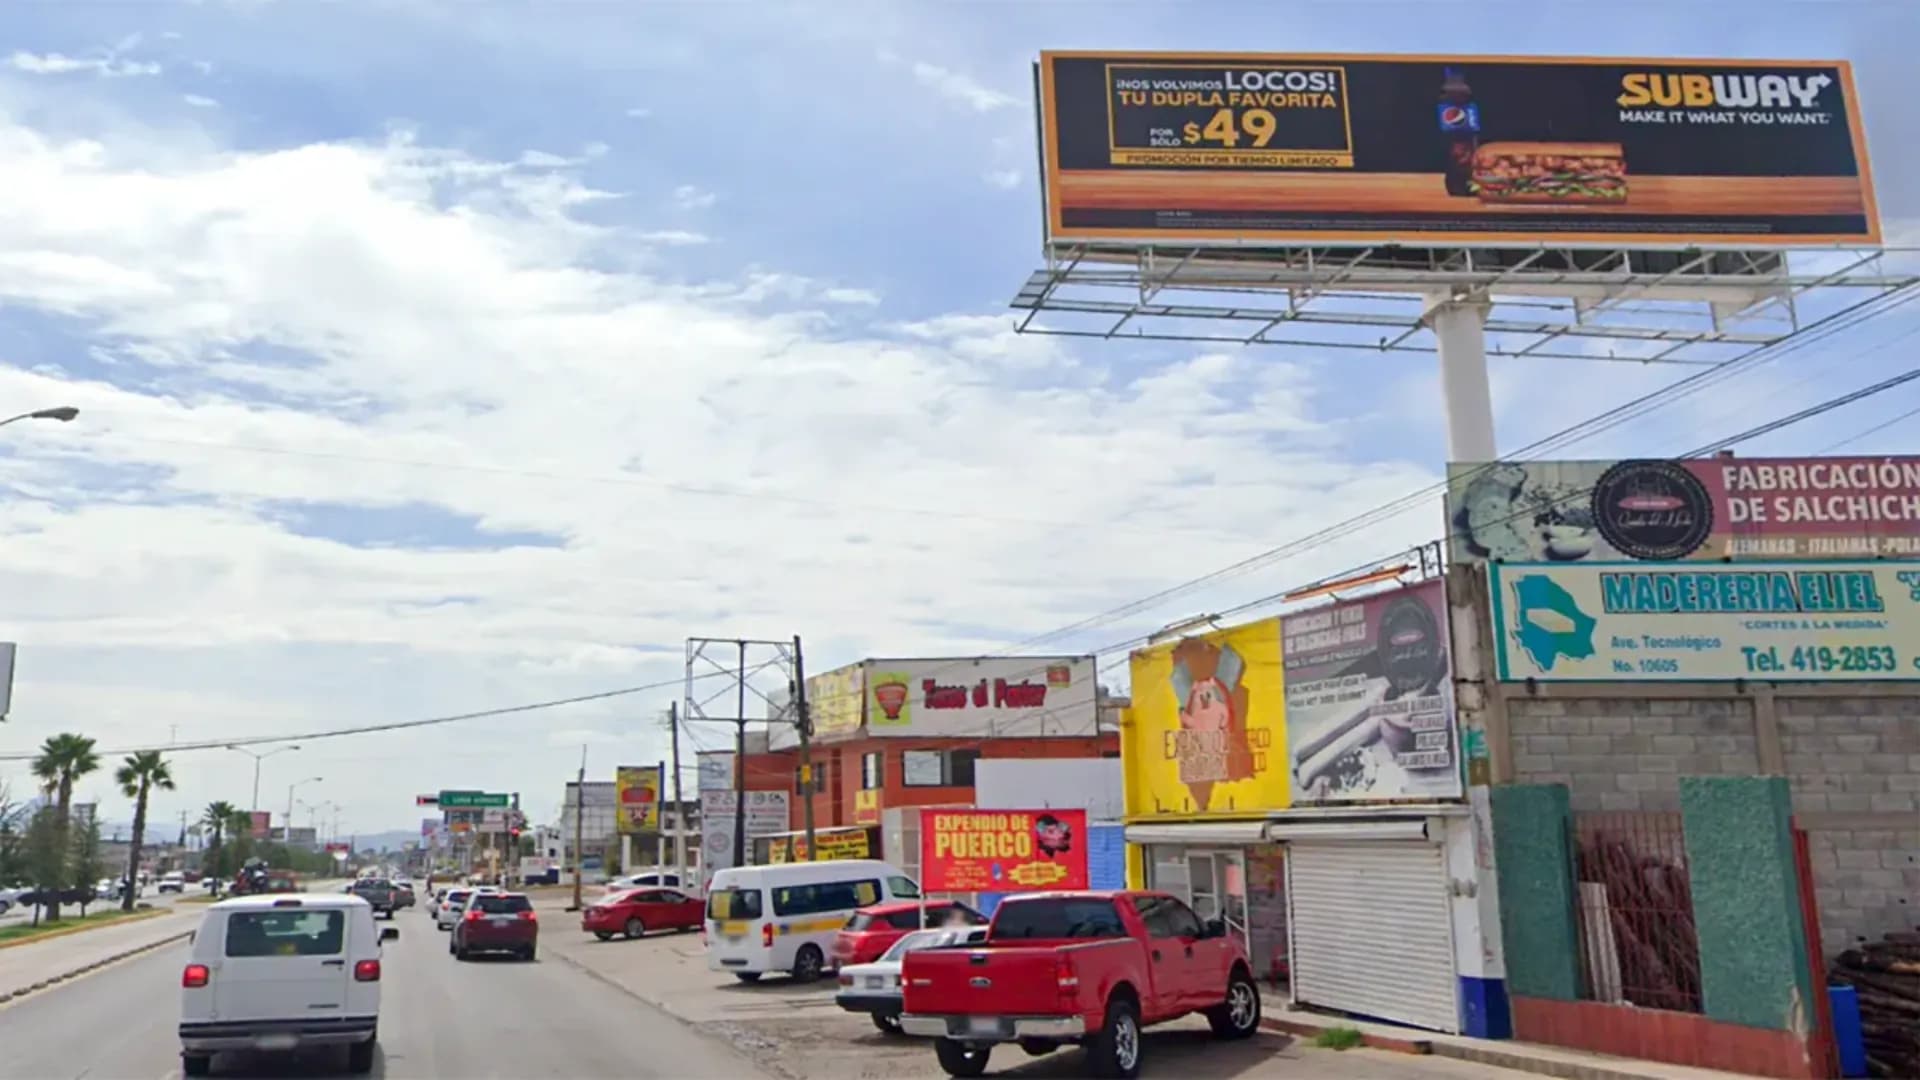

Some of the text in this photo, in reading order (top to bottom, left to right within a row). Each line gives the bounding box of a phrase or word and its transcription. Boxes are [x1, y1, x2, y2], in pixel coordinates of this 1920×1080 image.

[1152, 80, 1223, 91] VOLVIMOS
[1225, 71, 1337, 92] LOCOS!
[1617, 73, 1832, 108] SUBWAY
[1117, 91, 1337, 108] TU DUPLA FAVORITA
[1619, 110, 1666, 123] MAKE
[1669, 110, 1684, 123] IT
[1687, 111, 1735, 123] WHAT
[1739, 112, 1774, 124] YOU
[1150, 128, 1174, 137] POR
[1204, 155, 1228, 164] POR
[1232, 155, 1278, 165] TIEMPO
[1280, 156, 1338, 166] LIMITADO
[1722, 458, 1920, 491] FABRICACIÓN
[1728, 497, 1767, 523] DE
[1600, 572, 1798, 613] MADERERIA
[1795, 571, 1884, 612] ELIEL
[1814, 620, 1831, 629] LA
[1741, 646, 1785, 671] Tel.
[1790, 646, 1896, 671] 419-2853
[934, 814, 1029, 831] EXPENDIO DE
[935, 831, 1031, 858] PUERCO
